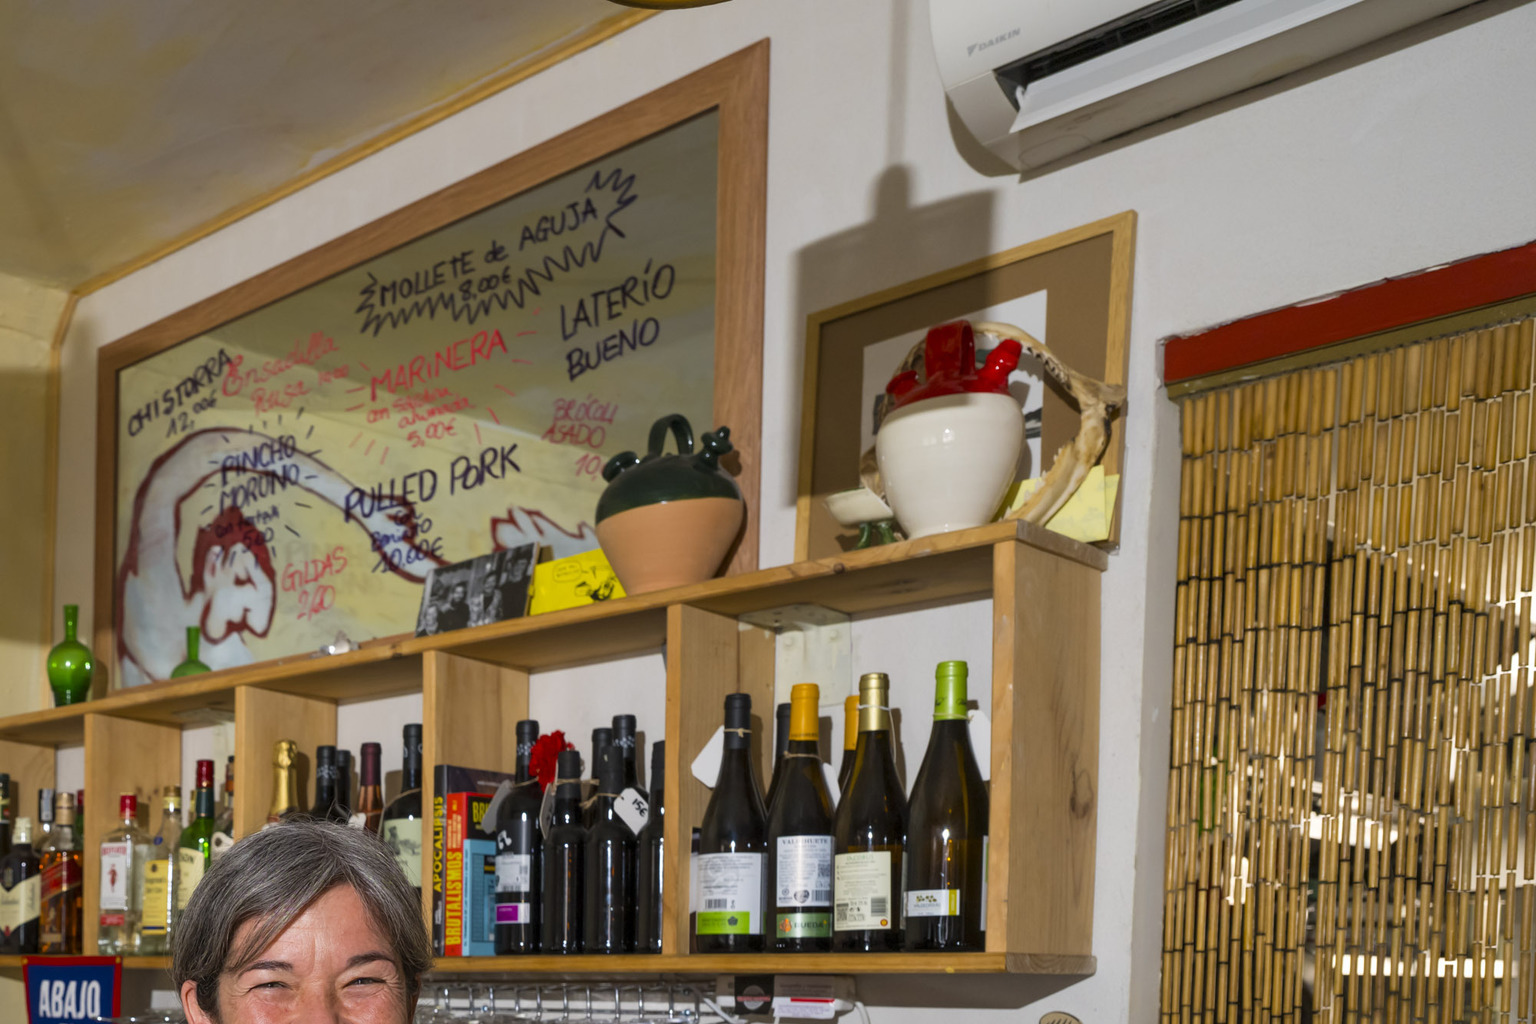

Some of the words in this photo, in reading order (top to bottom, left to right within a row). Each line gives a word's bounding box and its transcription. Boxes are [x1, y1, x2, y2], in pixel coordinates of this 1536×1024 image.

[978, 27, 1021, 51] DAIKIN
[379, 251, 475, 307] MOLLETE
[484, 239, 509, 264] de
[518, 197, 598, 250] AGUJA
[565, 317, 660, 382] BUENO
[219, 463, 300, 516] MORUNO
[222, 435, 297, 488] PINCHO
[345, 469, 438, 524] PULLED
[450, 443, 521, 496] PORK
[281, 546, 348, 592] GILDAS
[433, 796, 444, 893] APOCALIPSIS
[446, 851, 463, 946] BRUTALISMOS
[38, 980, 102, 1019] ABAJO
